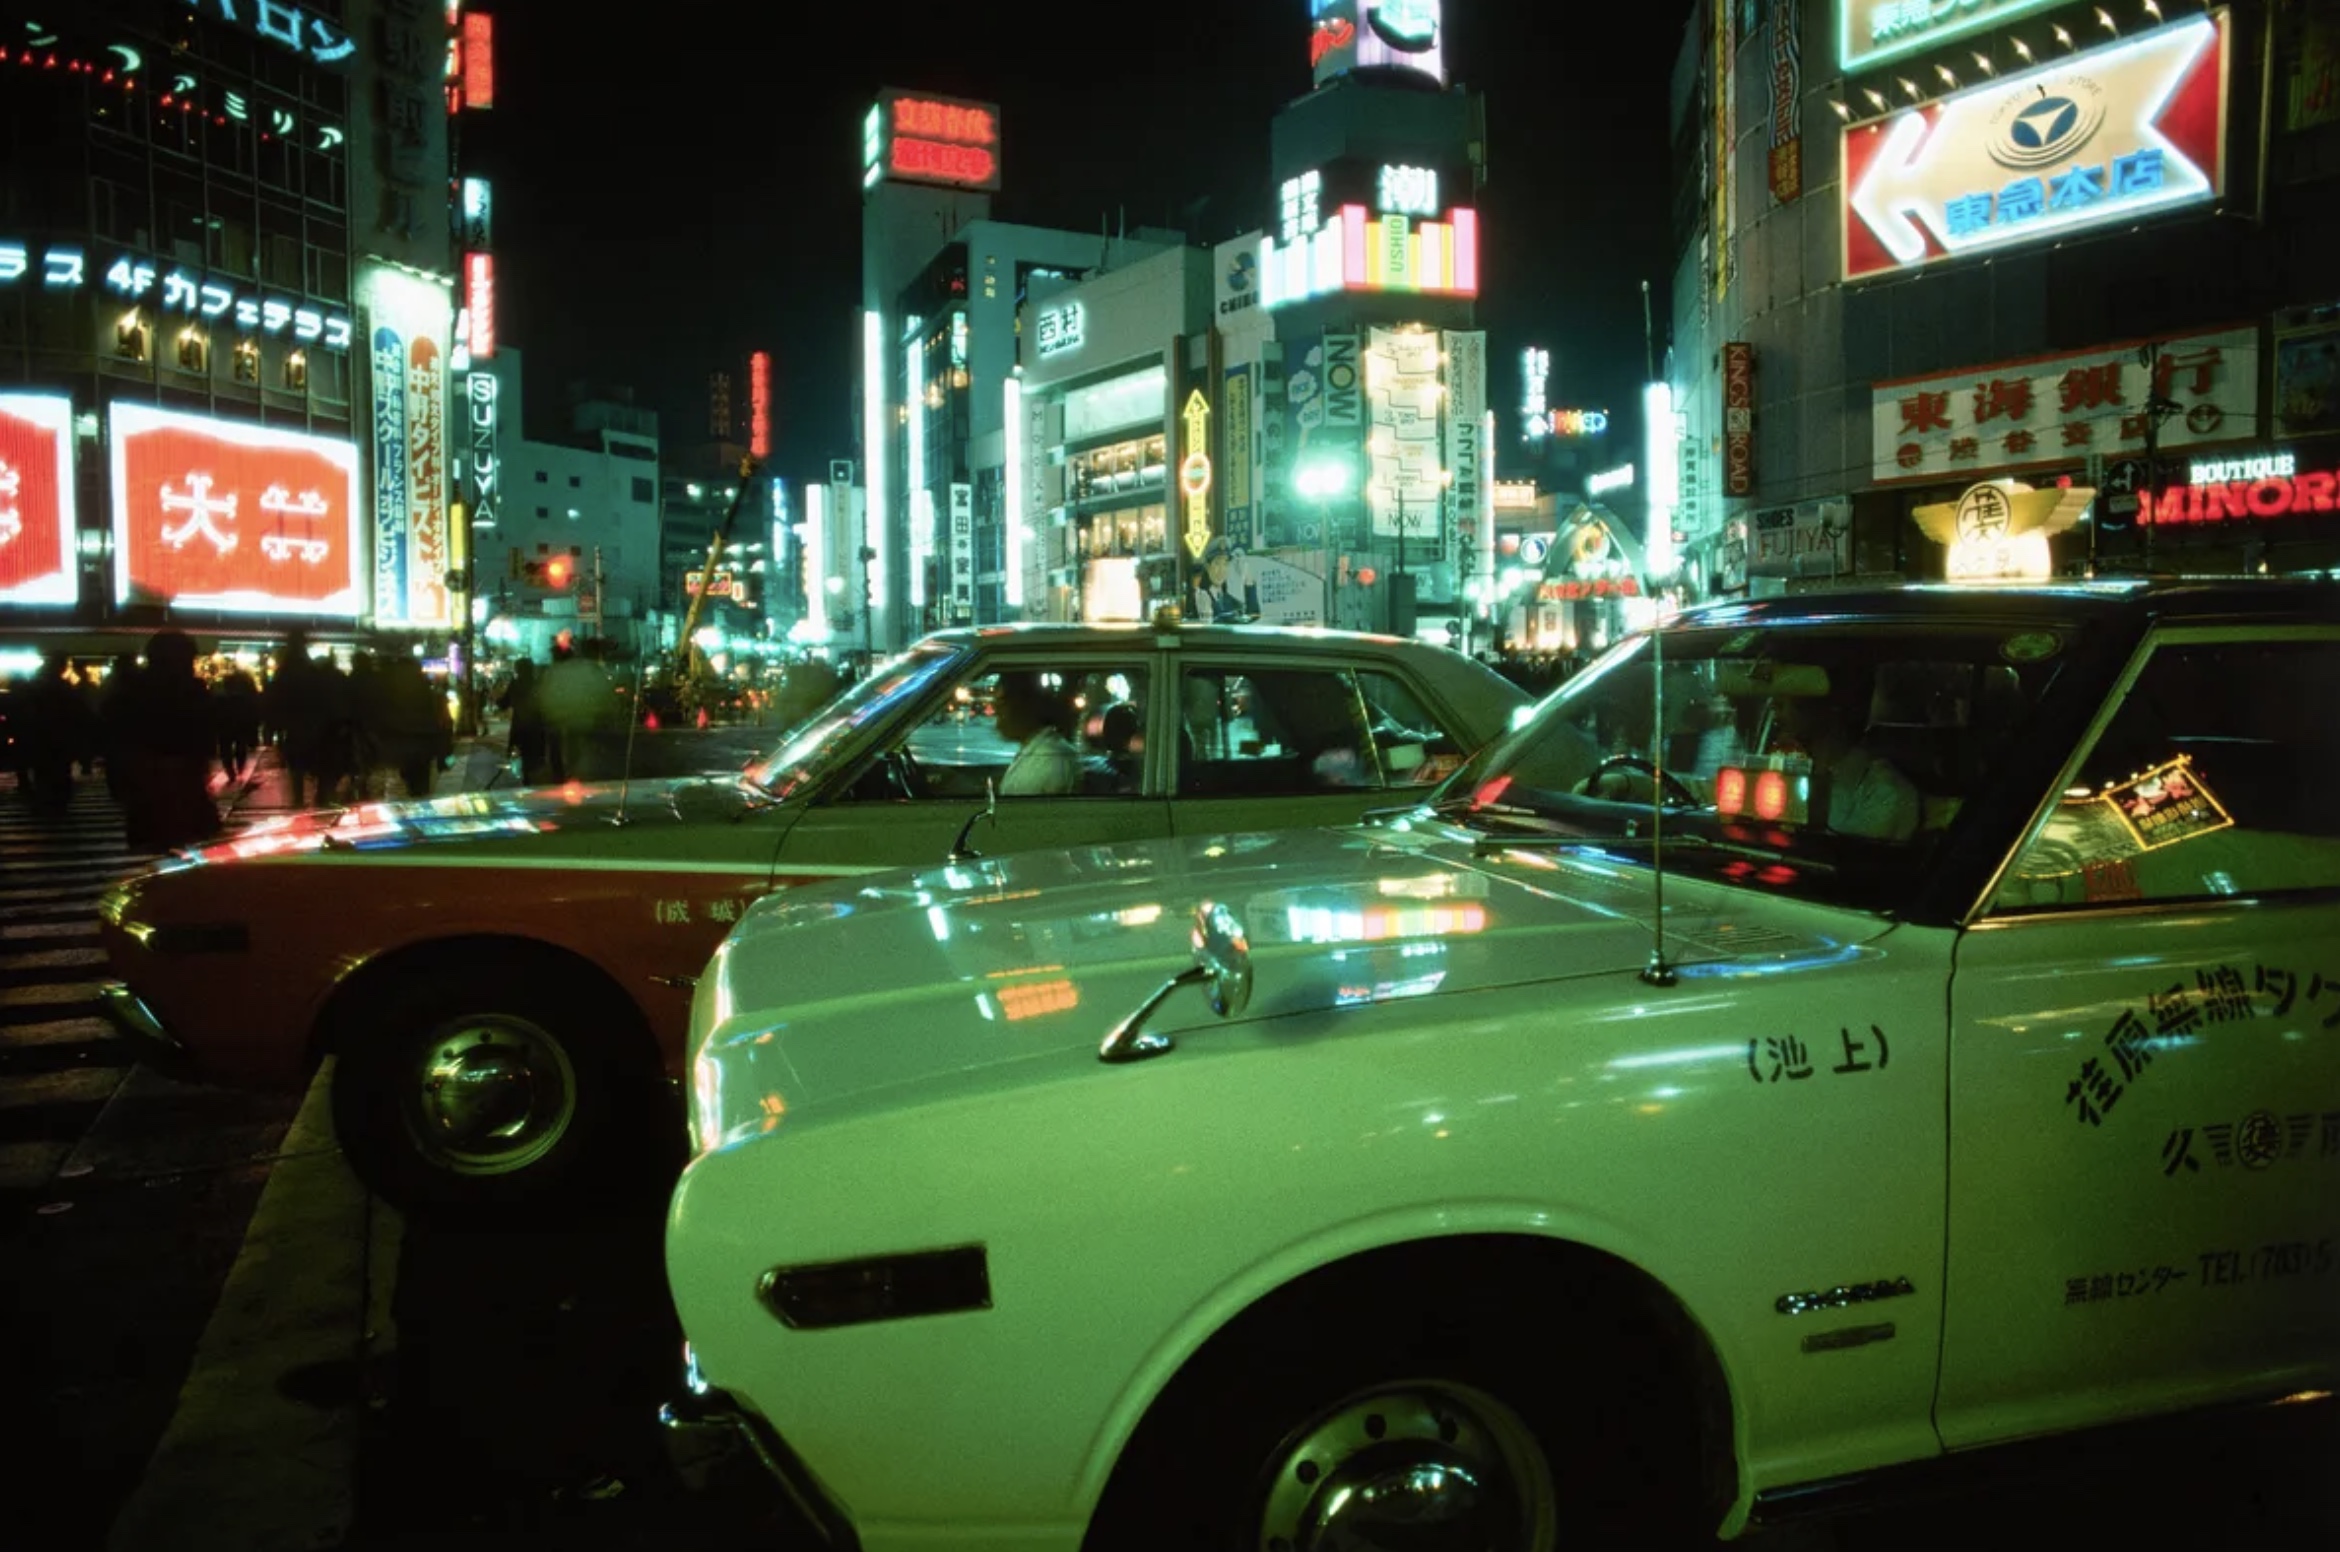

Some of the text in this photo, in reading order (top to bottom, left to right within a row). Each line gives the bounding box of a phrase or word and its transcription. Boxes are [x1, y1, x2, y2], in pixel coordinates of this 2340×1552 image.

[1945, 148, 2165, 236] 東急本店
[106, 258, 156, 294] 4F
[164, 272, 352, 348] カフェテラス
[1039, 304, 1079, 342] 西村
[1328, 340, 1356, 420] NOW
[1730, 345, 1748, 493] KINGS ROAD
[1897, 346, 2223, 434] 東海銀行
[473, 379, 494, 520] SUZUYA
[2191, 454, 2295, 484] BOUTIQUE
